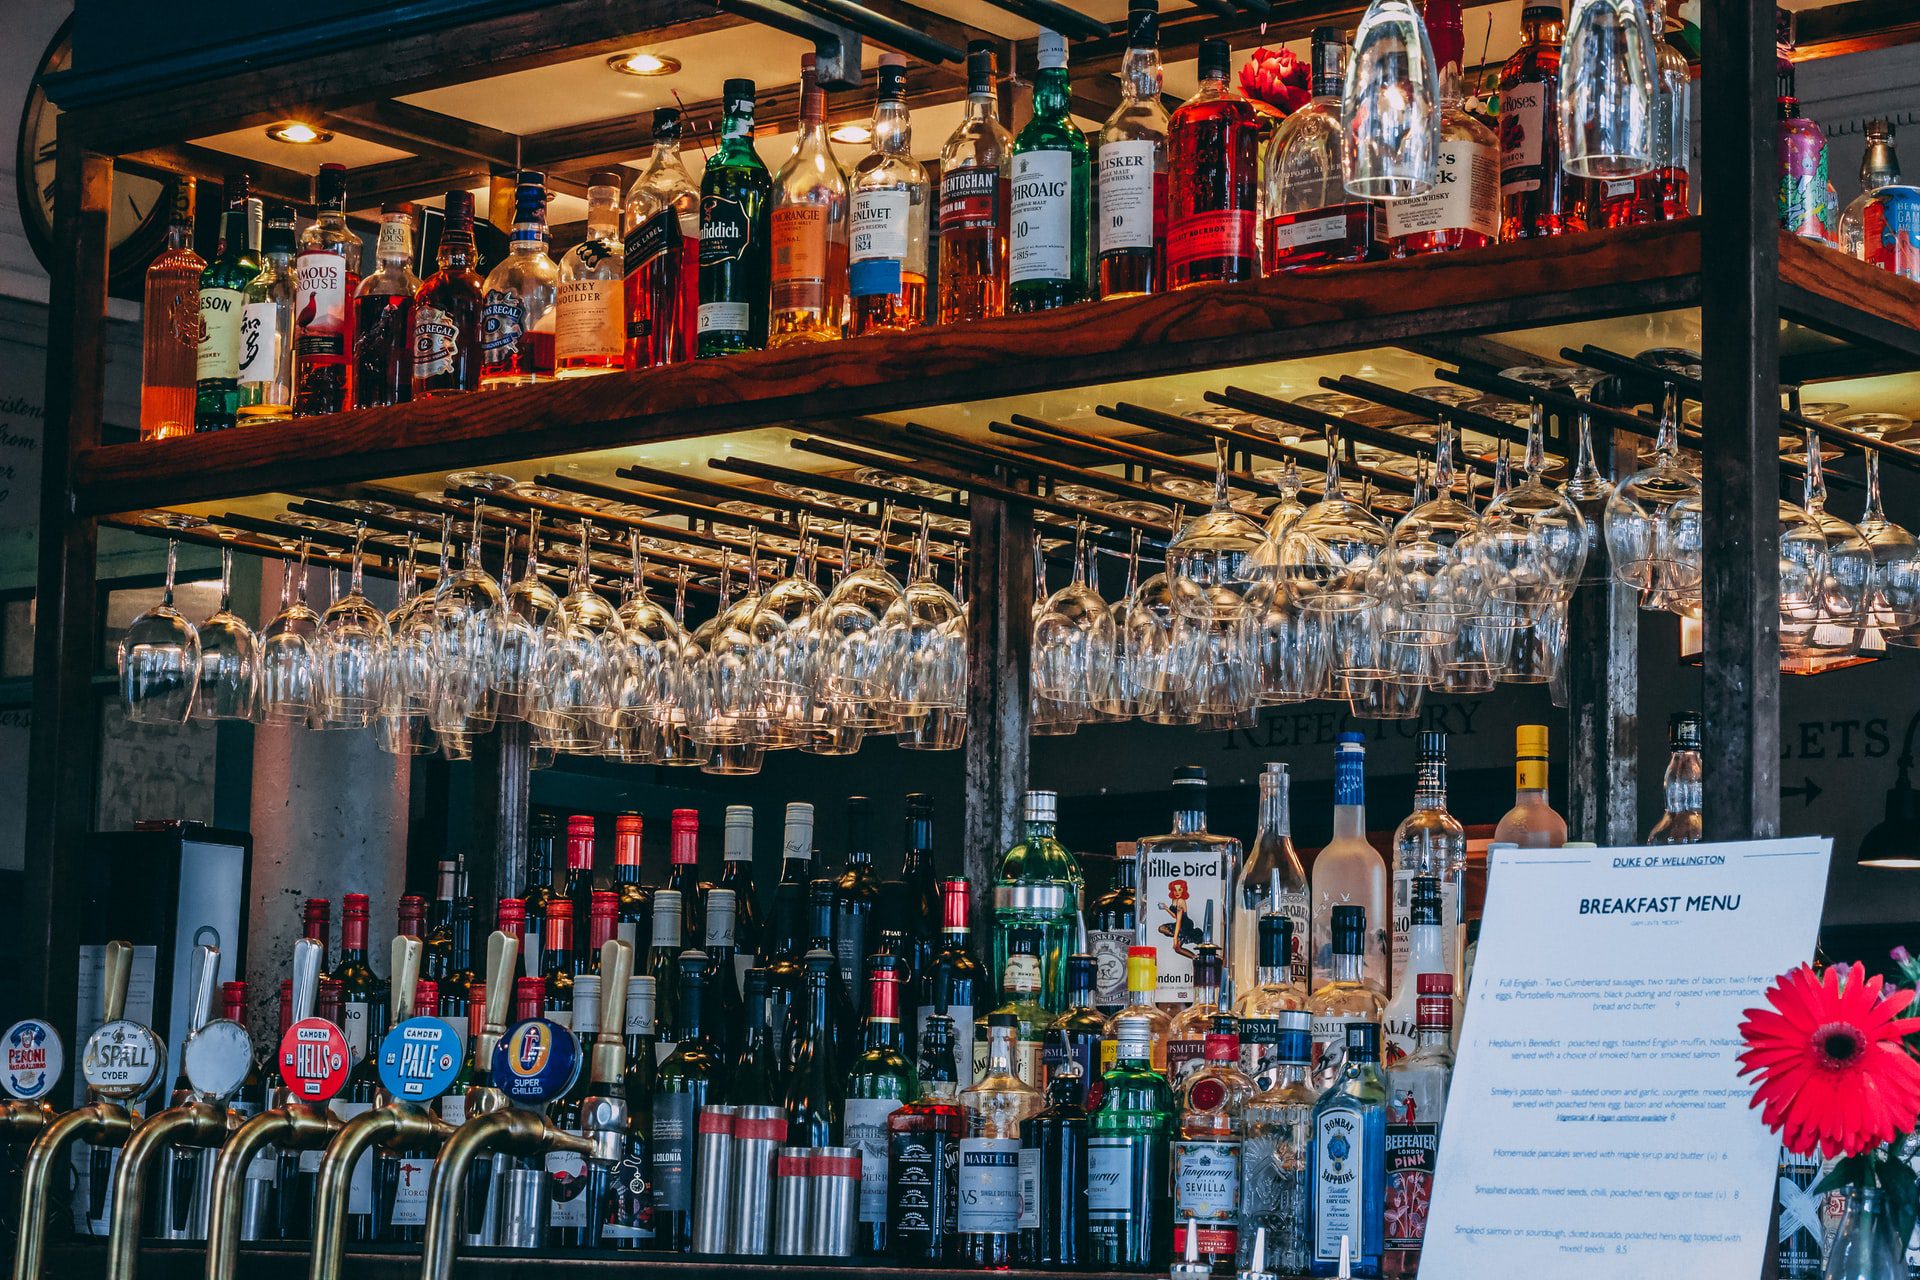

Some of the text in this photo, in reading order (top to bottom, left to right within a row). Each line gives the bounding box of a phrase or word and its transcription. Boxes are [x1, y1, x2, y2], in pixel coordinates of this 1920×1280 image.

[857, 200, 870, 210] THE
[954, 200, 966, 211] OAK
[1392, 192, 1450, 208] BOURBON WHISKY
[1112, 215, 1124, 228] 10
[642, 226, 664, 244] LABEL
[1016, 220, 1028, 238] 10
[855, 241, 872, 252] 1824
[1016, 250, 1029, 260] 1815
[558, 282, 596, 295] MONKEY
[493, 304, 518, 318] REGAL
[488, 320, 495, 331] 18
[700, 316, 710, 328] 12
[426, 324, 453, 337] REGAL
[420, 340, 428, 350] 12
[1613, 855, 1726, 868] DUKE OF WELLINGTON
[1184, 861, 1217, 877] bird
[1580, 894, 1741, 914] BREAKFAST MENU
[1119, 936, 1129, 944] 47
[1500, 978, 1512, 987] Full
[1514, 978, 1538, 990] English
[1546, 978, 1562, 986] Two
[1564, 978, 1611, 987] Cumberland
[1648, 978, 1664, 986] two
[1692, 976, 1702, 984] of
[1730, 976, 1746, 984] two
[1747, 975, 1763, 983] free
[1515, 991, 1555, 999] Portobello
[1604, 990, 1622, 998] black
[1624, 990, 1656, 1000] pudding
[1593, 1002, 1656, 1010] bread and butter
[300, 1030, 328, 1039] CAMDEN
[406, 1030, 439, 1038] CAMDEN
[1528, 1039, 1561, 1048] Benedict
[1568, 1038, 1600, 1048] poached
[1622, 1038, 1651, 1047] toasted
[1652, 1038, 1679, 1048] English
[8, 1048, 46, 1064] PERONI
[88, 1040, 150, 1068] ASPALL
[1512, 1052, 1537, 1060] served
[1538, 1052, 1555, 1060] with
[1562, 1052, 1588, 1060] choice
[1588, 1052, 1598, 1060] of
[1599, 1052, 1630, 1060] smoked
[1631, 1052, 1648, 1060] ham
[1660, 1050, 1691, 1059] smoked
[1693, 1050, 1720, 1059] salmon
[297, 1044, 330, 1079] HELLS
[398, 1042, 439, 1079] PALE
[102, 1070, 128, 1080] CYDER
[514, 1078, 540, 1087] SUPER
[512, 1086, 543, 1095] CHILLED
[1520, 1088, 1544, 1097] potato
[1546, 1088, 1562, 1096] hash
[1702, 1088, 1727, 1096] mixed
[1512, 1100, 1537, 1108] served
[1538, 1100, 1554, 1108] with
[1556, 1100, 1588, 1109] poached
[1324, 1118, 1355, 1134] BOMBAY
[1386, 1134, 1436, 1152] BEEFEATER
[656, 1152, 682, 1162] COLONIA
[965, 1154, 1016, 1165] MARTELL
[1494, 1148, 1704, 1160] Homemade pancakes served with maple syrup and butter
[1394, 1154, 1426, 1169] PINK
[1182, 1164, 1234, 1180] Tanqueray
[1322, 1169, 1356, 1185] SAPPHIRE
[1186, 1182, 1226, 1194] SEVILLA
[1475, 1185, 1508, 1194] Smashed
[1542, 1188, 1566, 1196] mixed
[1610, 1189, 1642, 1198] poached
[1664, 1191, 1680, 1200] eggs
[1694, 1191, 1713, 1199] toast
[961, 1189, 978, 1205] VS
[1456, 1224, 1485, 1235] Smoked
[1486, 1226, 1512, 1236] salmon
[1568, 1230, 1589, 1238] diced
[1625, 1232, 1658, 1240] poached
[1694, 1233, 1724, 1242] topped
[1725, 1234, 1742, 1242] with
[1560, 1244, 1582, 1252] mixed
